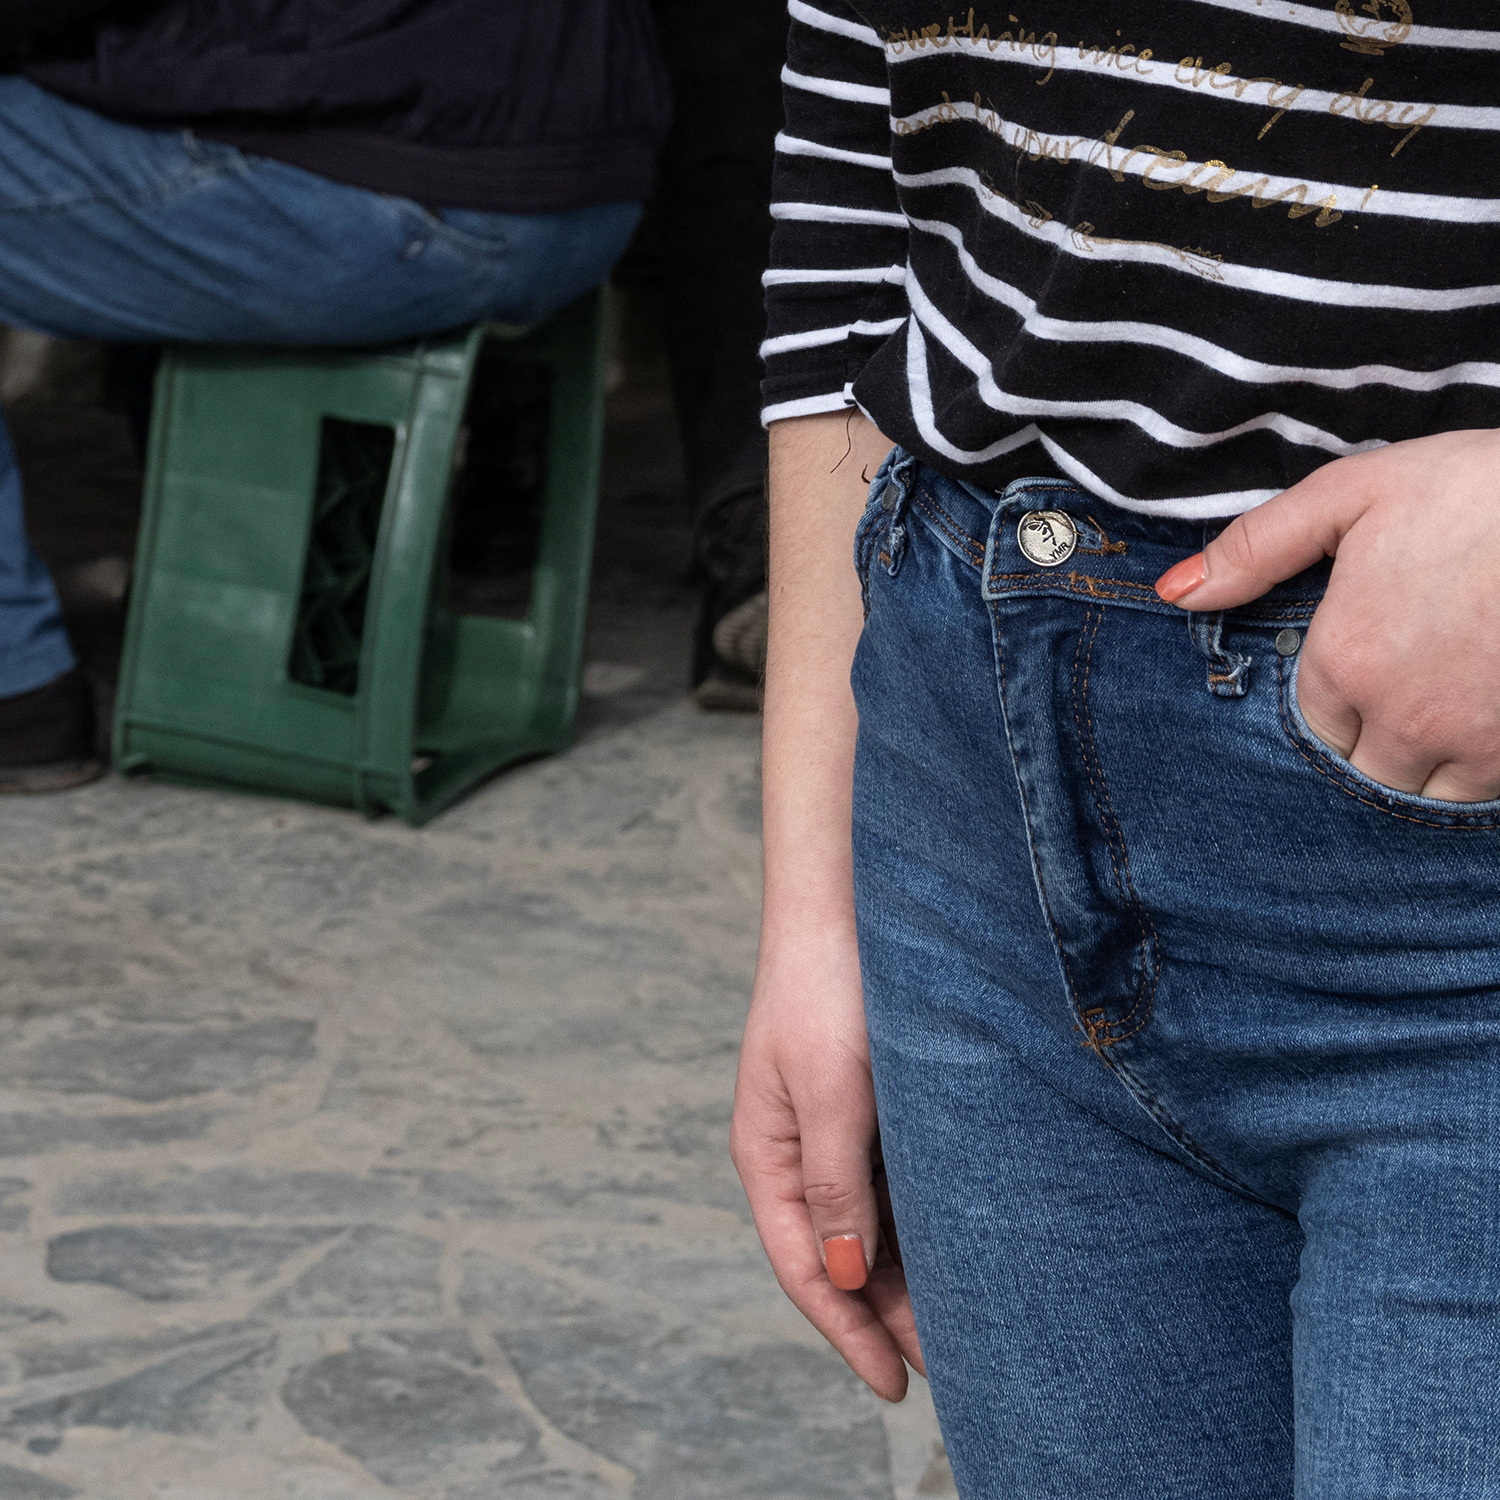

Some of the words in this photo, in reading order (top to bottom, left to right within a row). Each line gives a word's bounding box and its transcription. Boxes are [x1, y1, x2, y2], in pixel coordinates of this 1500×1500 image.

[1078, 29, 1154, 76] nice
[1173, 56, 1305, 141] every
[1328, 77, 1437, 158] day
[895, 90, 961, 137] and
[1013, 128, 1088, 180] your
[1088, 109, 1380, 229] dream!
[1048, 541, 1070, 561] YMR
